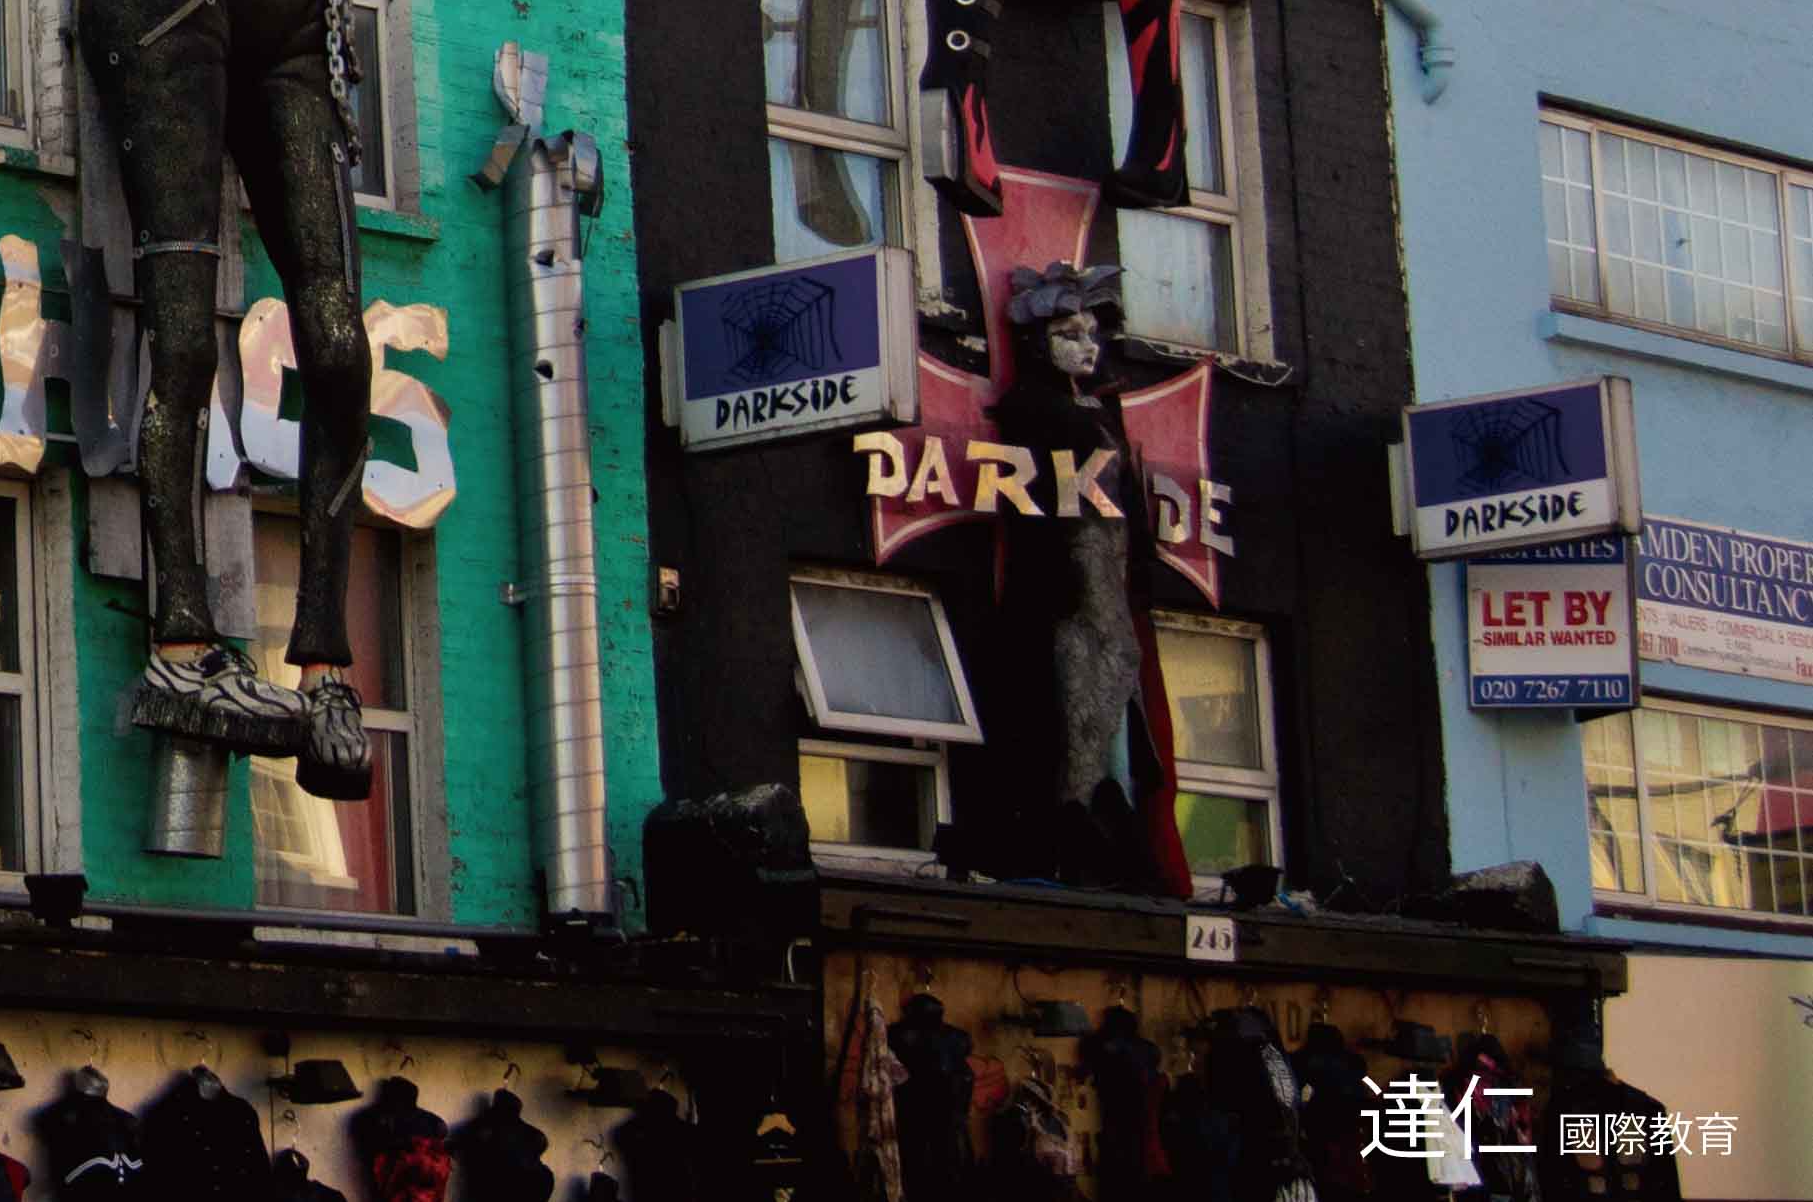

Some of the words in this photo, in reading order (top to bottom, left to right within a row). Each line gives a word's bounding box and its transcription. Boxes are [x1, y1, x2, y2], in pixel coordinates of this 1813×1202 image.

[716, 374, 858, 431] DARKSIDE
[1445, 491, 1586, 539] DARKSIDE
[1482, 591, 1551, 627] LET
[1564, 591, 1612, 626] BY
[1644, 562, 1813, 622] CONSULTANC
[1483, 630, 1546, 647] SIMILAR
[1550, 630, 1616, 646] WANTED
[1480, 680, 1516, 700] 020
[1523, 680, 1570, 700] 7267
[1577, 680, 1624, 699] 7110
[1191, 925, 1231, 951] 245
